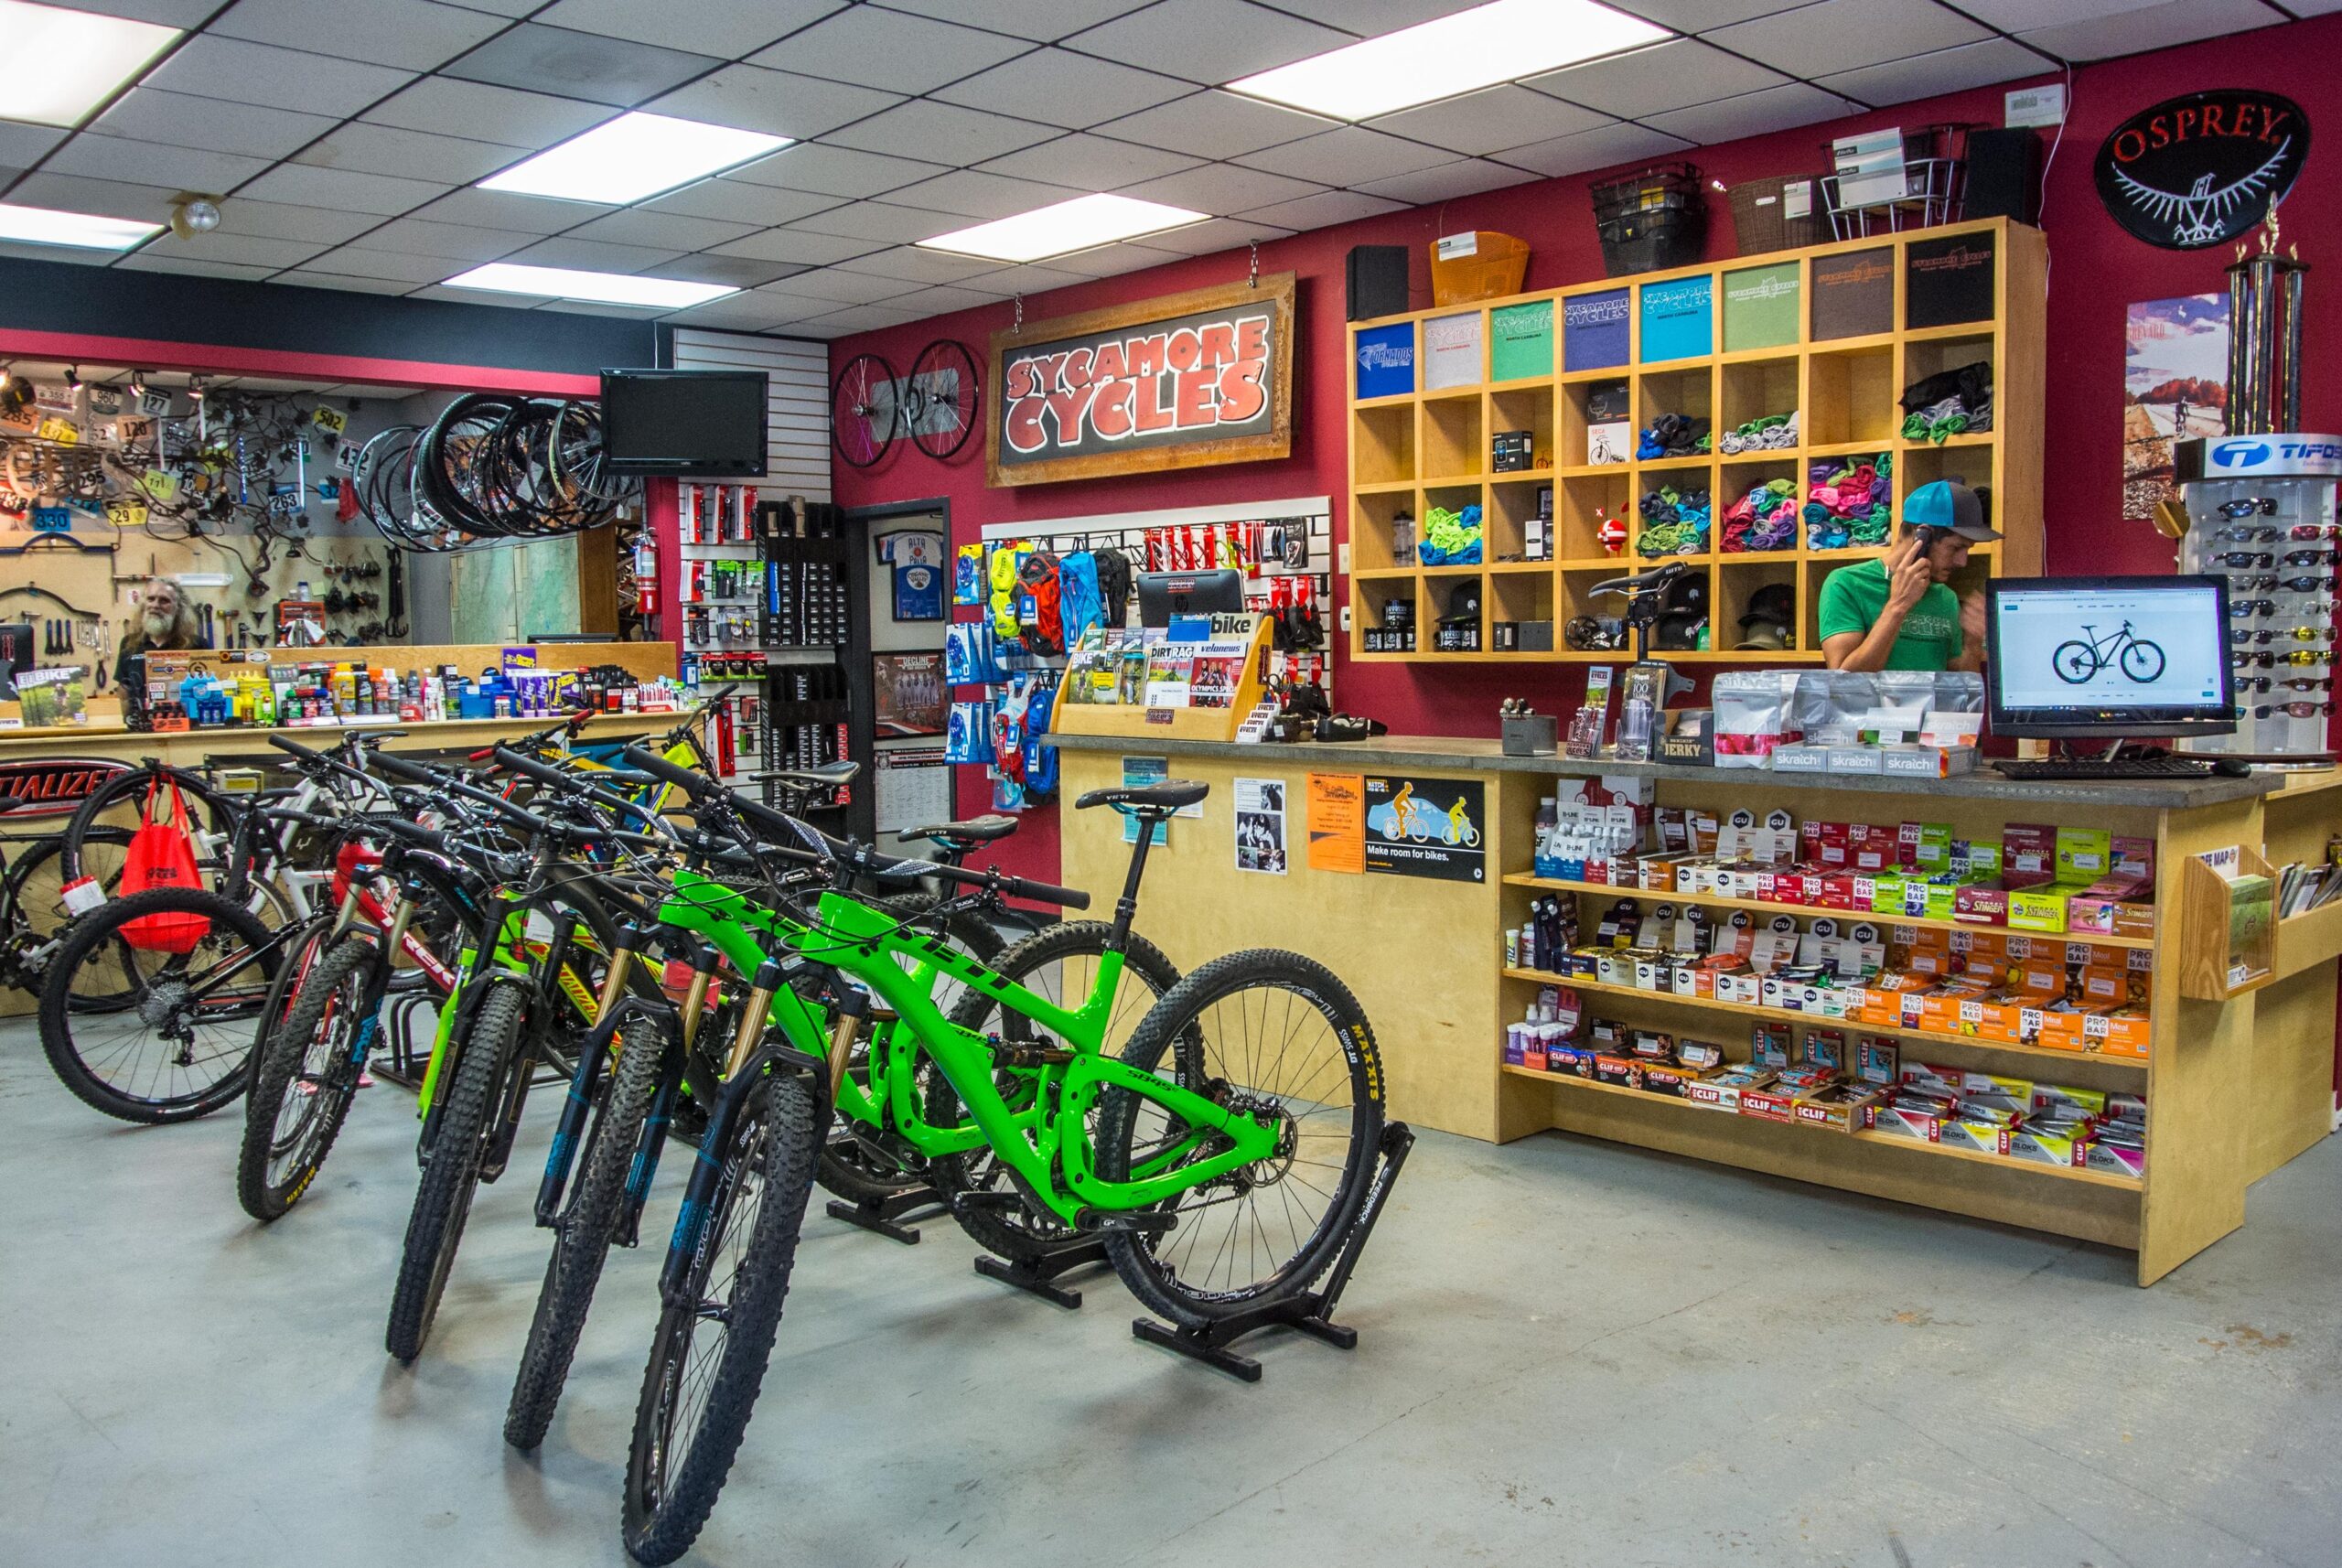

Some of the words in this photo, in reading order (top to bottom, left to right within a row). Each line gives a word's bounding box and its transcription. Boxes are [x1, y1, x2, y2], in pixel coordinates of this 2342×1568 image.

[2113, 103, 2290, 163] OSPREY
[1643, 284, 1713, 305] SYCAMORE
[1563, 298, 1629, 316] SYCAMORE
[1643, 293, 1713, 315] CYCLES
[1563, 307, 1629, 326] CYCLES
[1006, 316, 1270, 401] SYCAMORE
[97, 391, 115, 404] 960
[144, 395, 166, 412] 127
[1005, 359, 1269, 454] CYCLES
[320, 409, 342, 431] 502
[1591, 428, 1606, 436] SECA
[274, 494, 297, 510] 263
[115, 510, 130, 523] 29
[1210, 616, 1252, 634] bike
[1151, 647, 1171, 659] DIRT
[1172, 647, 1194, 659] RAG
[1200, 644, 1241, 653] velonews
[903, 656, 929, 666] DECLINE
[1073, 651, 1092, 664] BIKE
[35, 670, 70, 682] BIKE
[1633, 683, 1649, 693] 100
[1665, 744, 1702, 757] JERKY
[1777, 753, 1817, 766] skratch
[1832, 754, 1874, 768] skratch
[1888, 757, 1929, 771] skratch
[1735, 816, 1747, 824] GU
[1902, 826, 1920, 834] PRO
[1368, 845, 1389, 855] Make
[1391, 849, 1411, 858] room
[1412, 849, 1424, 858] for
[1425, 850, 1449, 861] bikes.
[2214, 850, 2229, 867] MAP
[1951, 858, 1970, 867] PRO
[1718, 875, 1729, 884] GU
[1856, 879, 1873, 887] PRO
[1856, 888, 1873, 897] BAR
[1907, 884, 1926, 893] PRO
[1907, 893, 1926, 901] BAR
[1620, 903, 1632, 911] GU
[1972, 900, 2004, 915] STINGER
[2025, 906, 2059, 920] STINGER
[1857, 931, 1872, 940] GU
[1896, 926, 1916, 935] PRO
[1951, 931, 1971, 940] PRO
[1951, 941, 1971, 950] BAR
[2008, 938, 2029, 947] PRO
[2068, 944, 2090, 953] PRO
[2008, 947, 2029, 957] BAR
[2068, 953, 2090, 962] BAR
[2130, 950, 2153, 961] PRO
[2129, 960, 2152, 970] BAR
[1846, 997, 1864, 1005] BAR
[1866, 993, 1883, 1003] Meal
[1903, 995, 1921, 1004] PRO
[1925, 1001, 1942, 1010] Meal
[1903, 1004, 1921, 1013] BAR
[1961, 1003, 1981, 1011] PRO
[1983, 1008, 2001, 1017] Meal
[1961, 1011, 1981, 1020] BAR
[2022, 1010, 2041, 1019] PRO
[2044, 1015, 2062, 1025] Meal
[2086, 1016, 2107, 1026] PRO
[2111, 1022, 2129, 1032] Meal
[2086, 1026, 2108, 1035] BAR
[1338, 1029, 1353, 1050] SWISS
[1808, 1034, 1816, 1054] CLIF
[1551, 1053, 1564, 1061] CLIF
[1861, 1041, 1869, 1062] CLIF
[1348, 1052, 1358, 1064] DT
[1351, 1024, 1380, 1101] MAXXIS
[1599, 1063, 1614, 1071] CLIF
[1695, 1089, 1719, 1101] CLIF
[1748, 1098, 1770, 1111] CLIF
[1802, 1107, 1826, 1120] CLIF
[1876, 1116, 1900, 1126] BLOKS
[1929, 1120, 1938, 1137] CLIF
[1941, 1129, 1967, 1140] BLOKS
[739, 1126, 751, 1147] SWISS
[2012, 1142, 2037, 1152] BLOKS
[2077, 1144, 2085, 1161] CLIF
[2088, 1154, 2116, 1165] BLOKS
[285, 1165, 317, 1205] MAXXIS
[1359, 1180, 1383, 1226] FEEDBACK
[1103, 1219, 1116, 1227] GX
